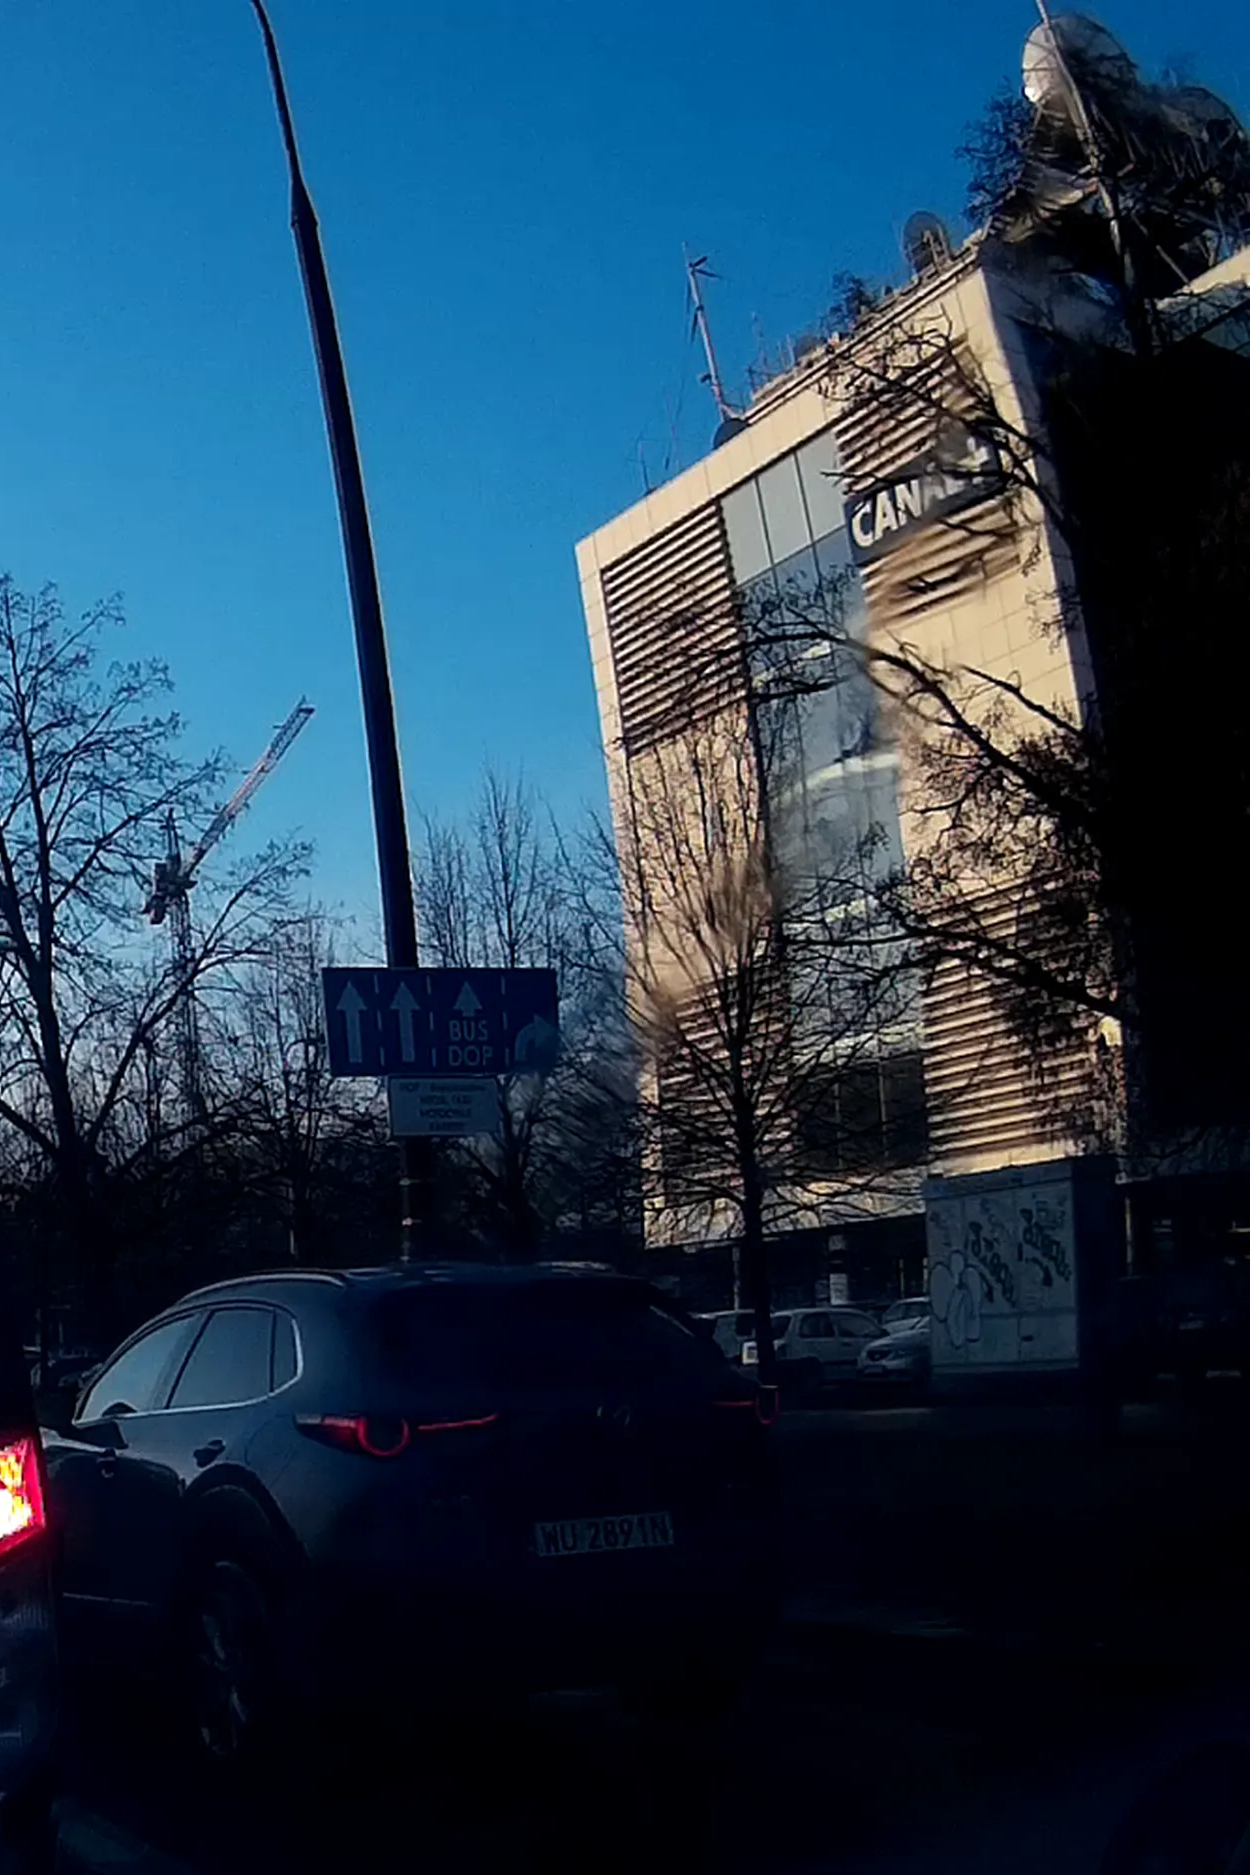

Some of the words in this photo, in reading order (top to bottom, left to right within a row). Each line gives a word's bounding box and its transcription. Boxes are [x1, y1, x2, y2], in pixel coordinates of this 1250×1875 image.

[450, 1020, 488, 1042] BUS
[449, 1046, 493, 1066] DOP
[540, 1523, 578, 1554] WU
